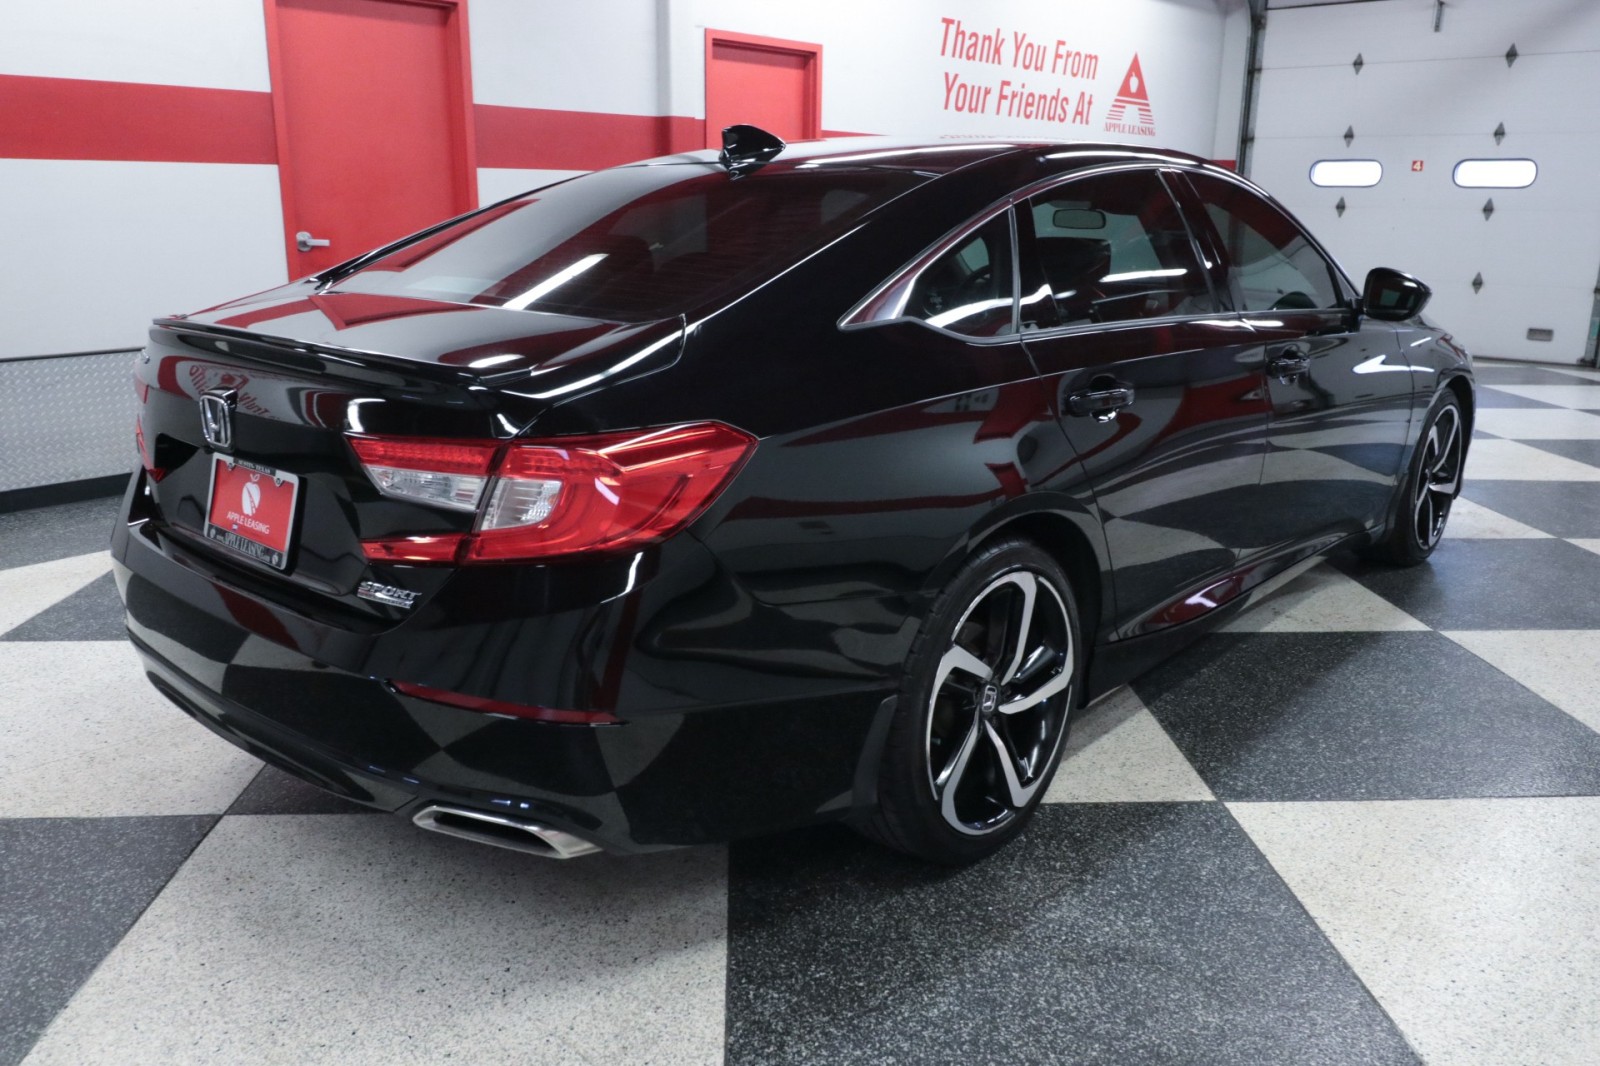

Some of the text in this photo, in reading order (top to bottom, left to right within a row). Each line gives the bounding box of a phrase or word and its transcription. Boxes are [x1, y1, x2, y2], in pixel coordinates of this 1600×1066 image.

[940, 17, 1099, 80] Thank You From
[943, 72, 1093, 125] Your Friends At
[1103, 122, 1155, 137] APPLE LEASING
[226, 511, 271, 535] APPLE LEASING
[359, 581, 422, 600] SPORT
